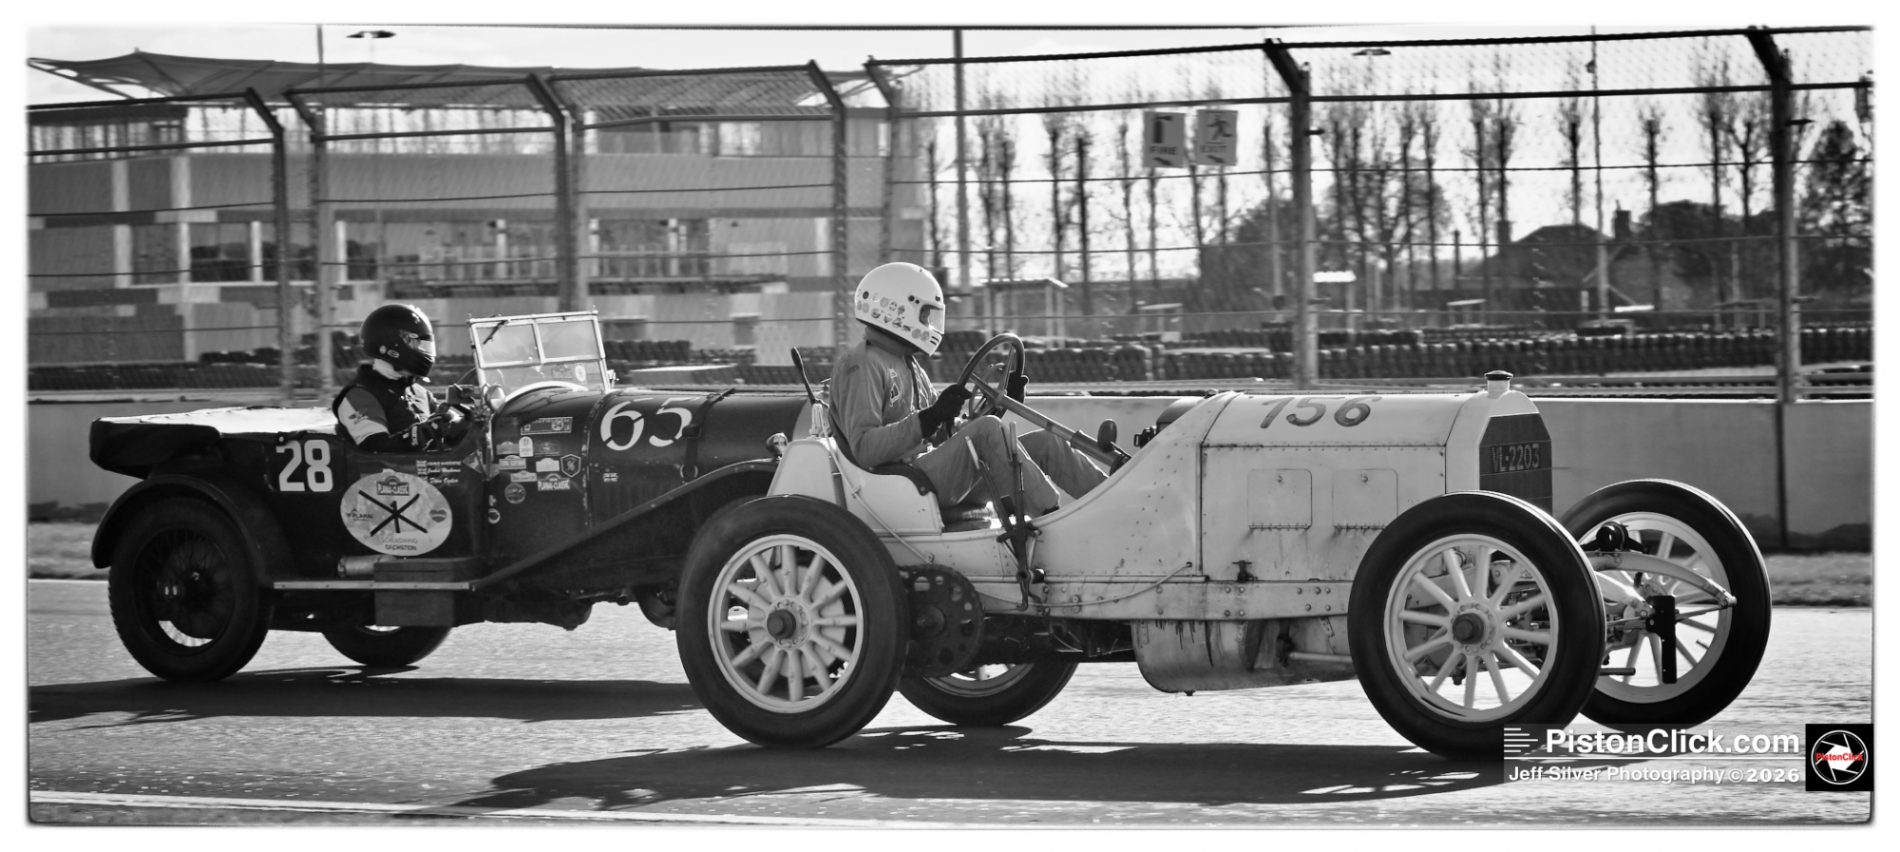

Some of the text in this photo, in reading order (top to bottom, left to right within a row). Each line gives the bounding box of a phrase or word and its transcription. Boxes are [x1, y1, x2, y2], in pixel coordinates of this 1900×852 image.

[1150, 146, 1177, 155] FIRE
[600, 397, 701, 451] 65
[1259, 395, 1382, 429] 156
[276, 439, 333, 493] 28
